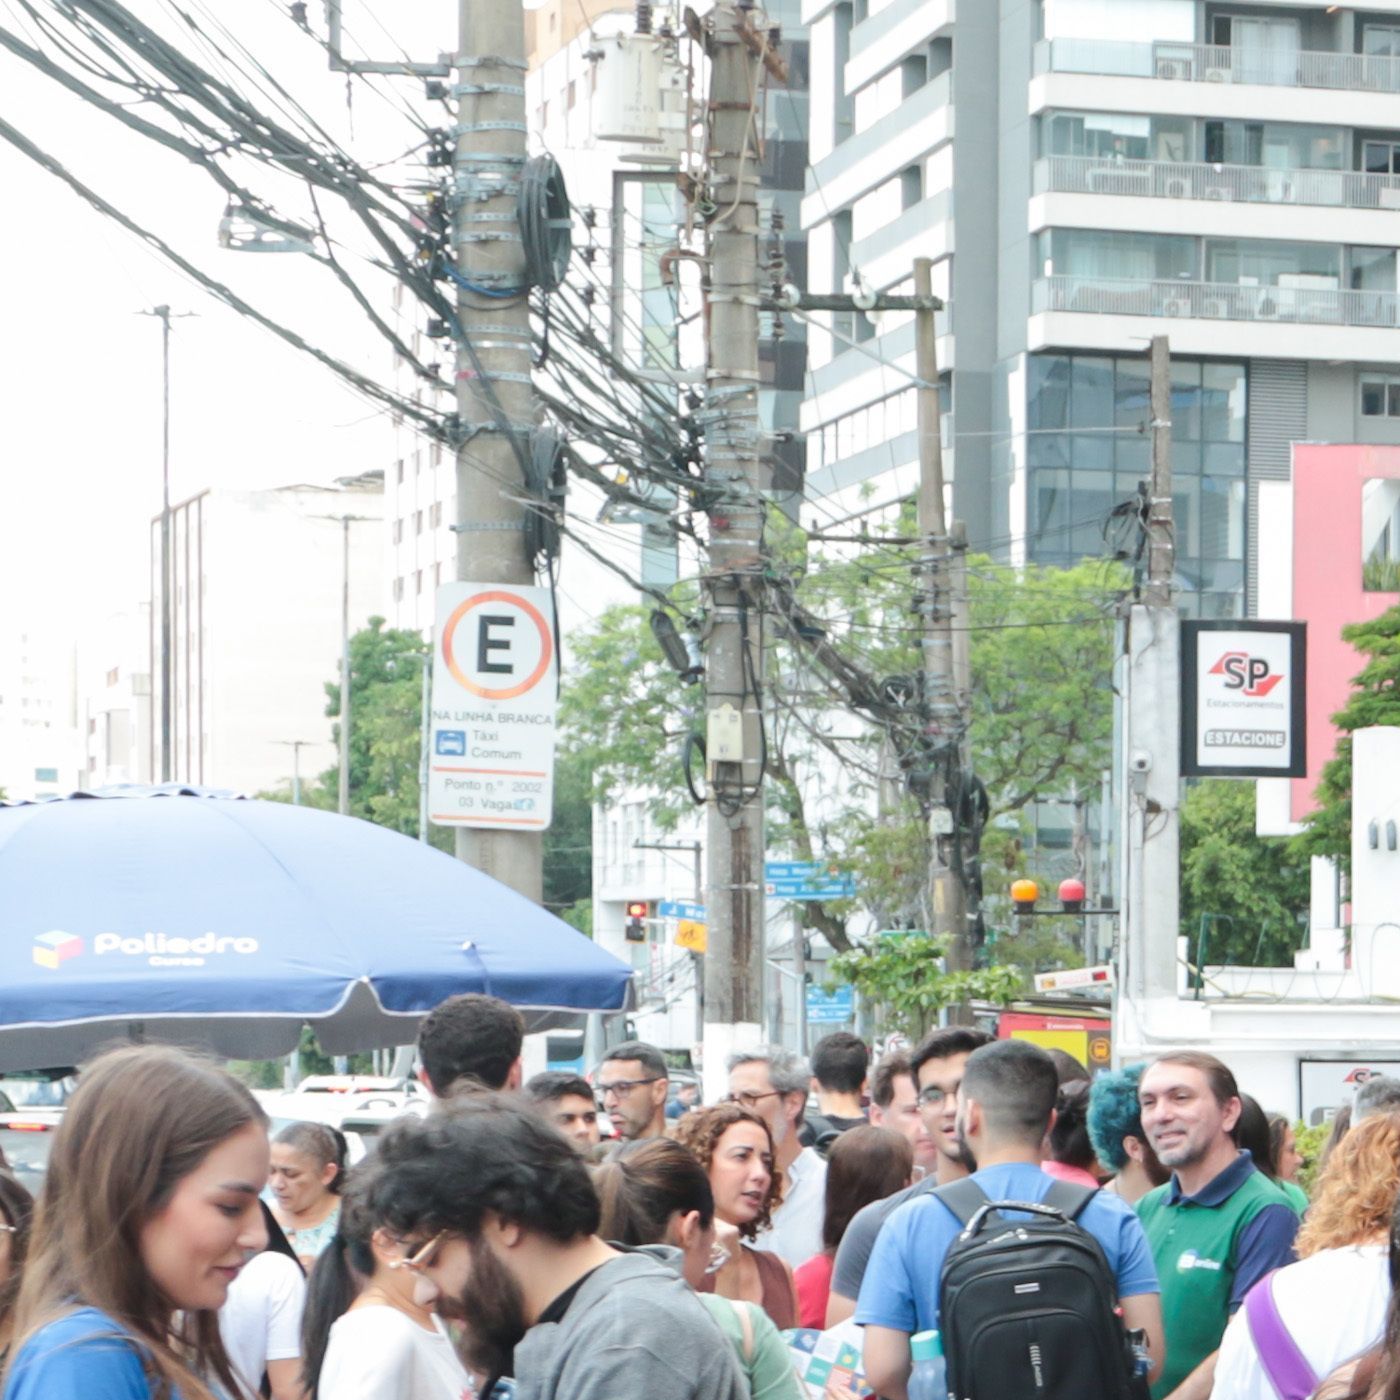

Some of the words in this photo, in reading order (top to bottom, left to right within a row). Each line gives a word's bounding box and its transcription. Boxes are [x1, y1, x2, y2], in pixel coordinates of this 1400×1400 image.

[477, 614, 515, 674] E
[1223, 657, 1269, 689] SP
[432, 710, 450, 721] NA
[455, 711, 494, 723] LINHA
[498, 713, 552, 725] BRANCA
[1206, 731, 1284, 746] ESTACIONE
[471, 746, 522, 760] Comum
[444, 777, 482, 791] Ponto
[511, 781, 542, 793] 2002
[459, 796, 474, 808] 03
[94, 931, 258, 955] Poliedro
[148, 955, 206, 967] Curso
